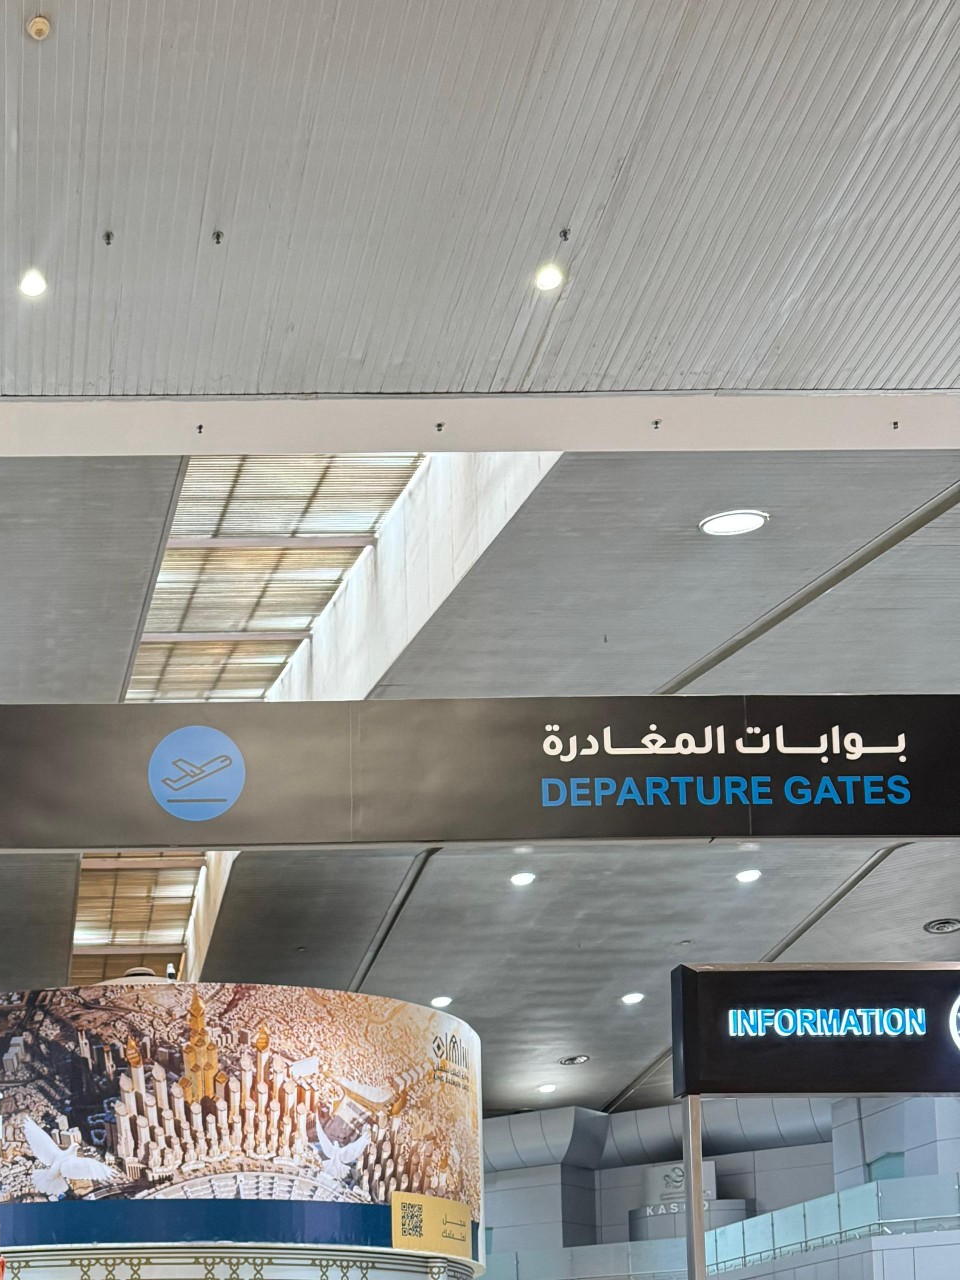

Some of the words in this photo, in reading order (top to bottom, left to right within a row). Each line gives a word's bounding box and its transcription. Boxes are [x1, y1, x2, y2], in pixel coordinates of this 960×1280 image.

[542, 724, 726, 762] المغادرة
[735, 723, 907, 763] بوابات
[541, 776, 773, 807] DEPARTURE
[784, 775, 912, 806] GATES
[728, 1008, 927, 1037] INFORMATION
[646, 1201, 709, 1216] KASO
